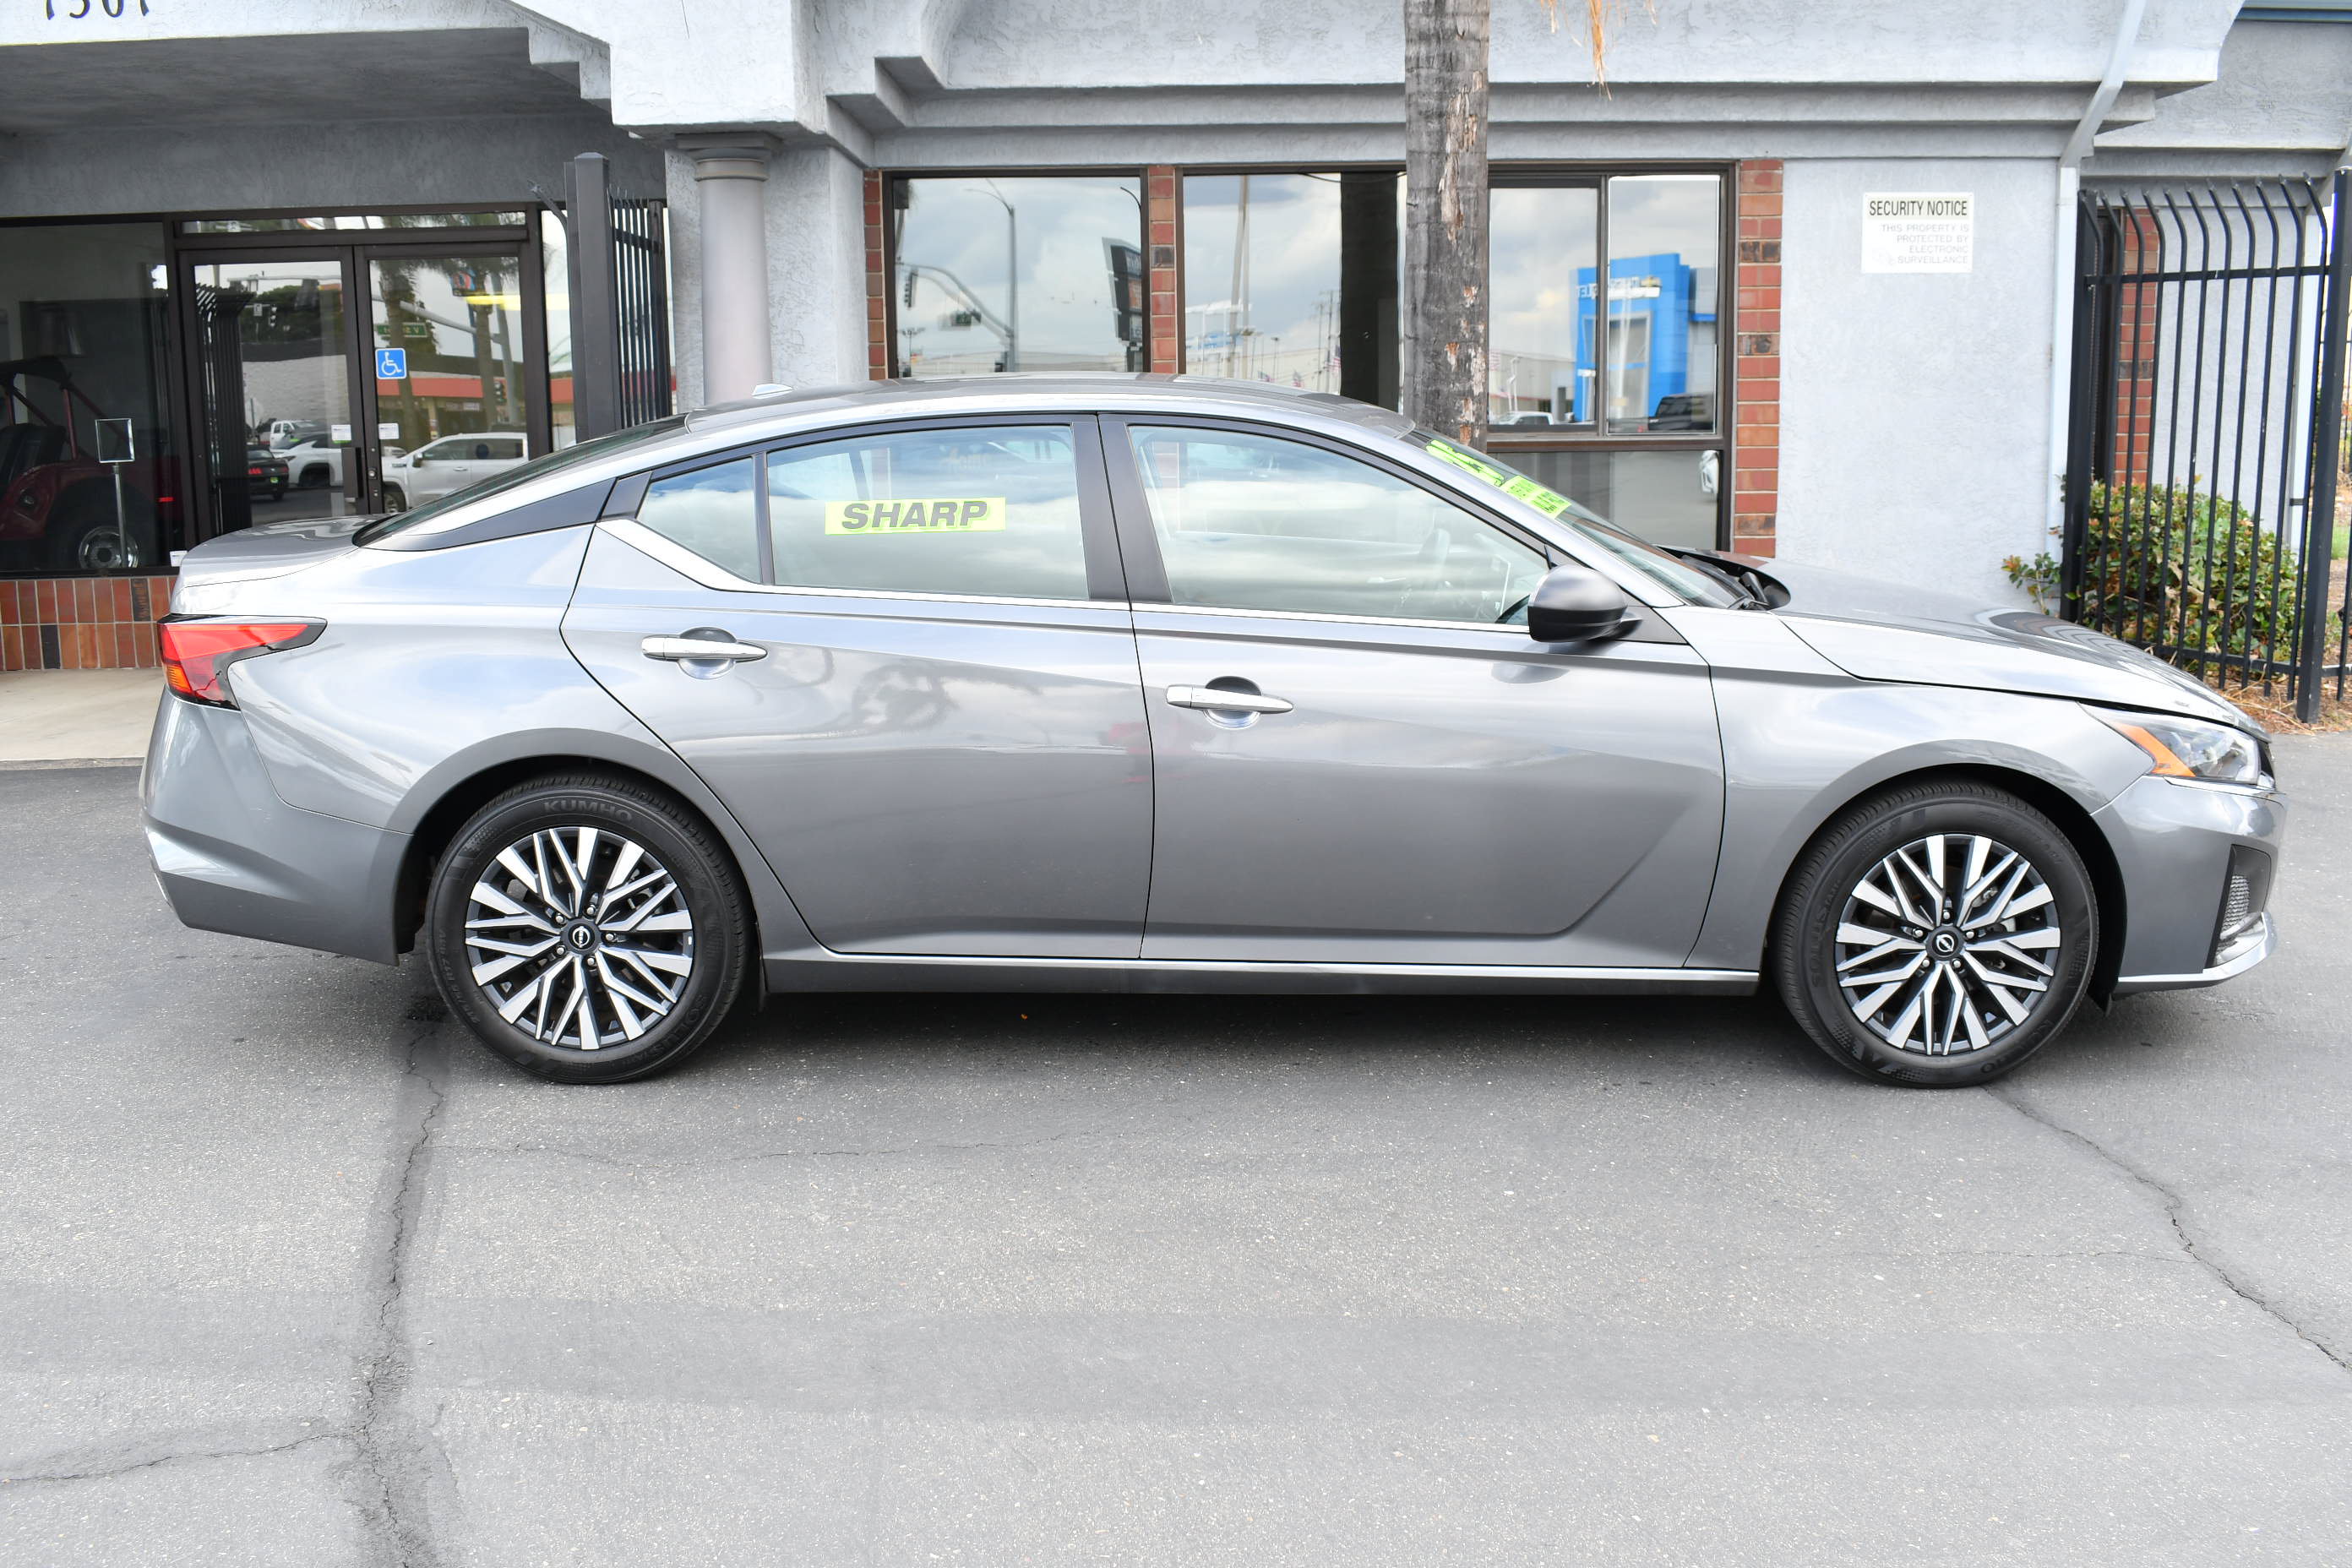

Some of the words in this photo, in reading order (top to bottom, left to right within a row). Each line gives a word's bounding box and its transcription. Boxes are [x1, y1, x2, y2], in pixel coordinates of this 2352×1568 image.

[1870, 200, 1924, 215] SECURITY
[1927, 200, 1968, 215] NOTICE
[1881, 224, 1903, 232] THIS
[1907, 224, 1956, 232] PROPERTY
[1960, 224, 1969, 232] IS
[1897, 235, 1952, 243] PROTECTED
[1957, 235, 1968, 243] BY
[1909, 245, 1968, 253] ELECTRONIC
[1897, 256, 1968, 264] SURVEILLANCE
[842, 501, 988, 529] SHARP
[543, 799, 633, 822] KUMHO
